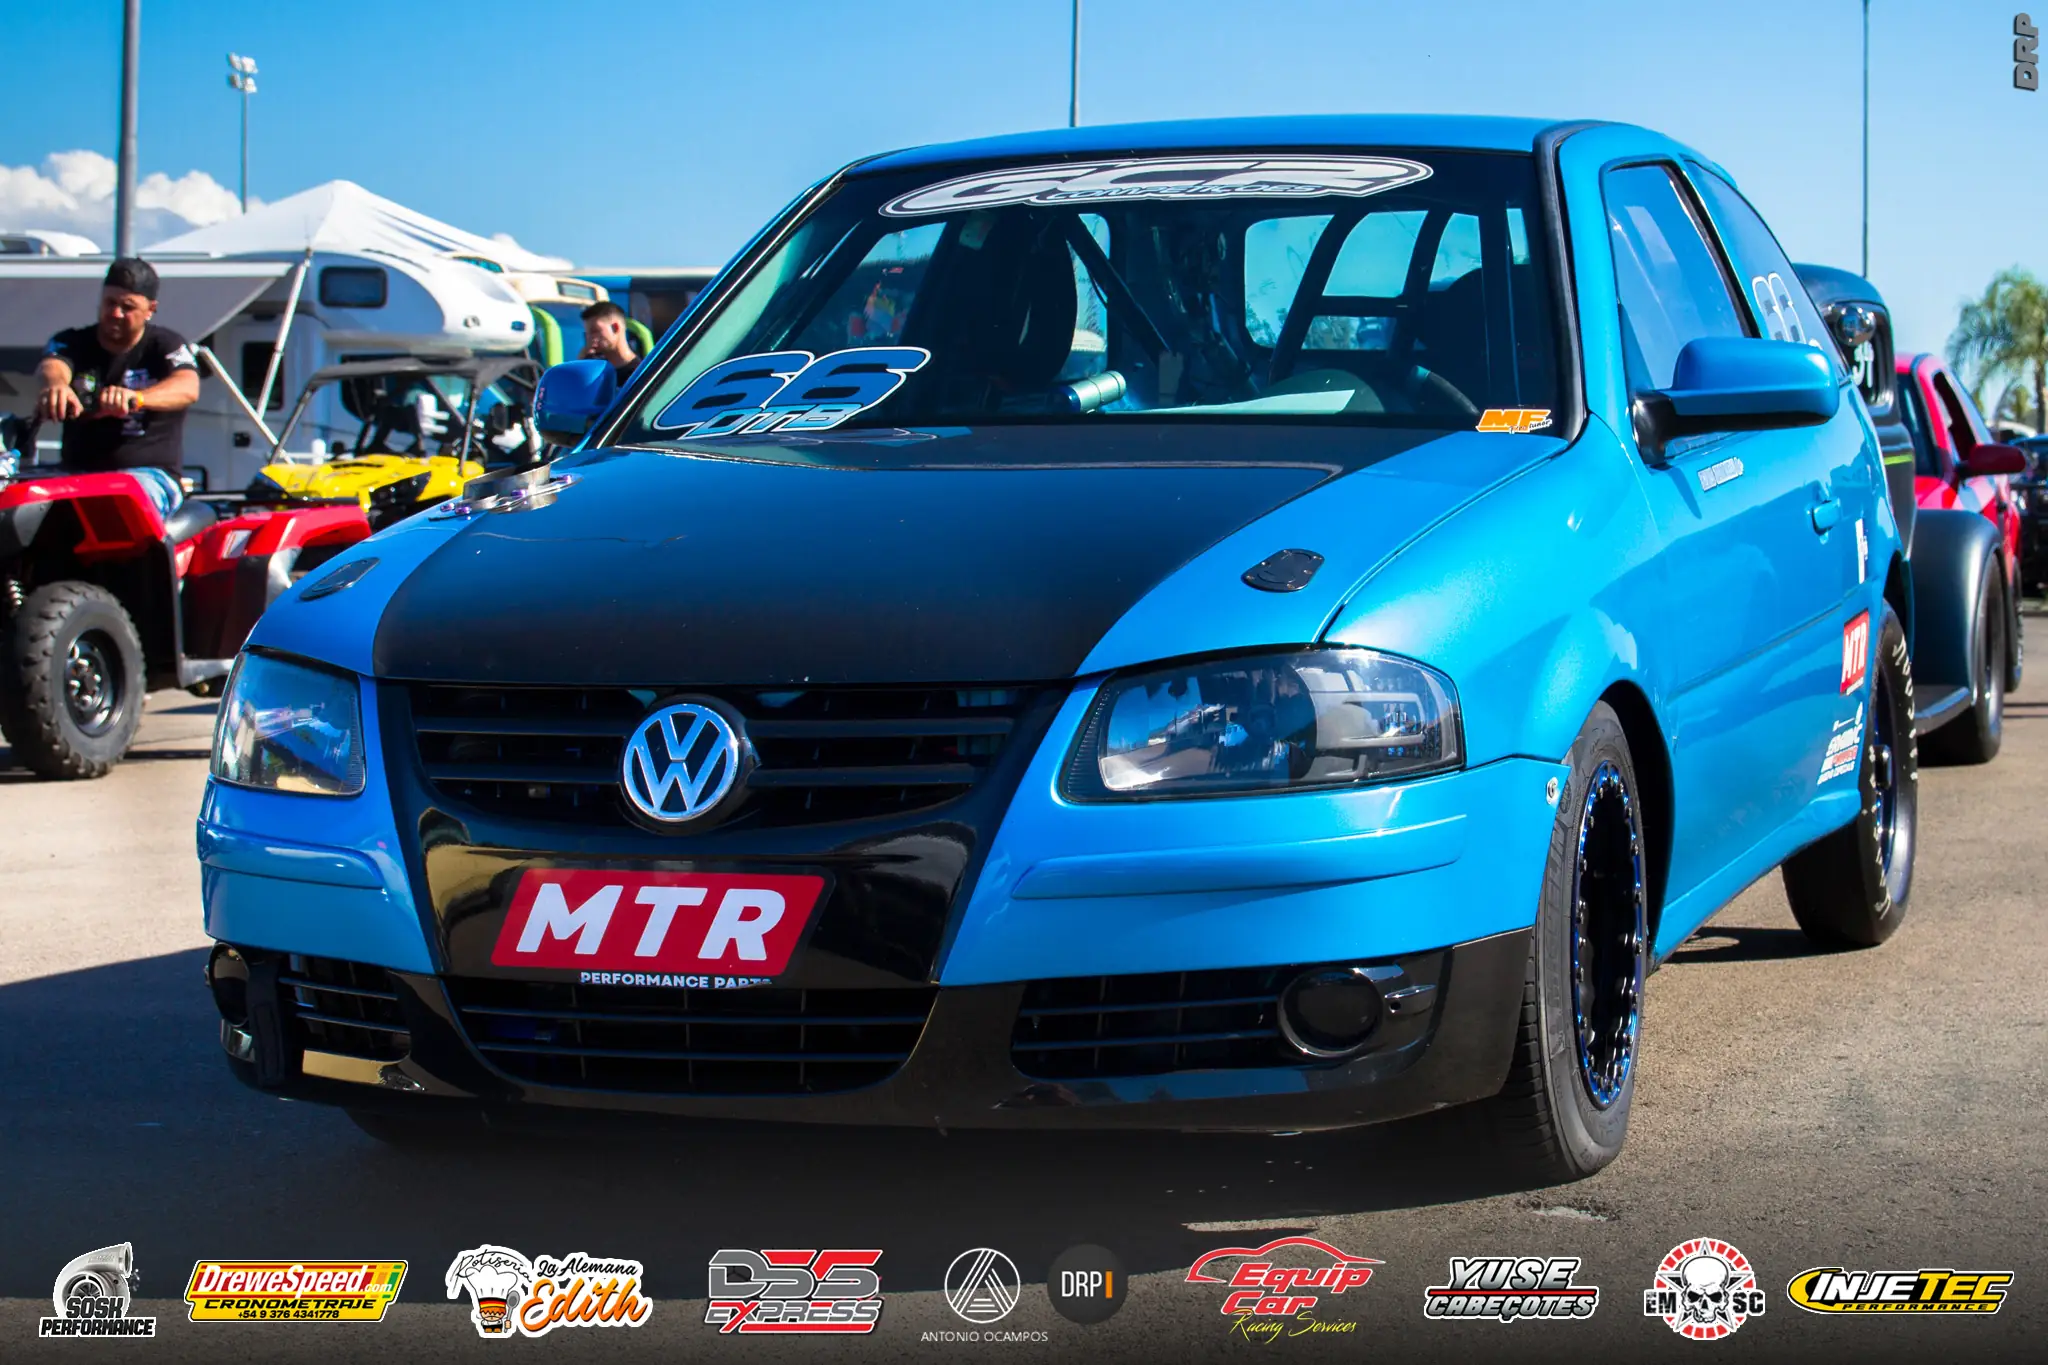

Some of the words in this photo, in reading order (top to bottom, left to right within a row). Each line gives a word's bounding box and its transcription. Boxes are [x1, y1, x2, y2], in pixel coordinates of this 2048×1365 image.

[653, 346, 932, 430] 66
[1478, 409, 1551, 432] MF
[1841, 622, 1867, 684] MTR
[516, 883, 786, 961] MTR
[580, 971, 709, 989] PERFORMANCE
